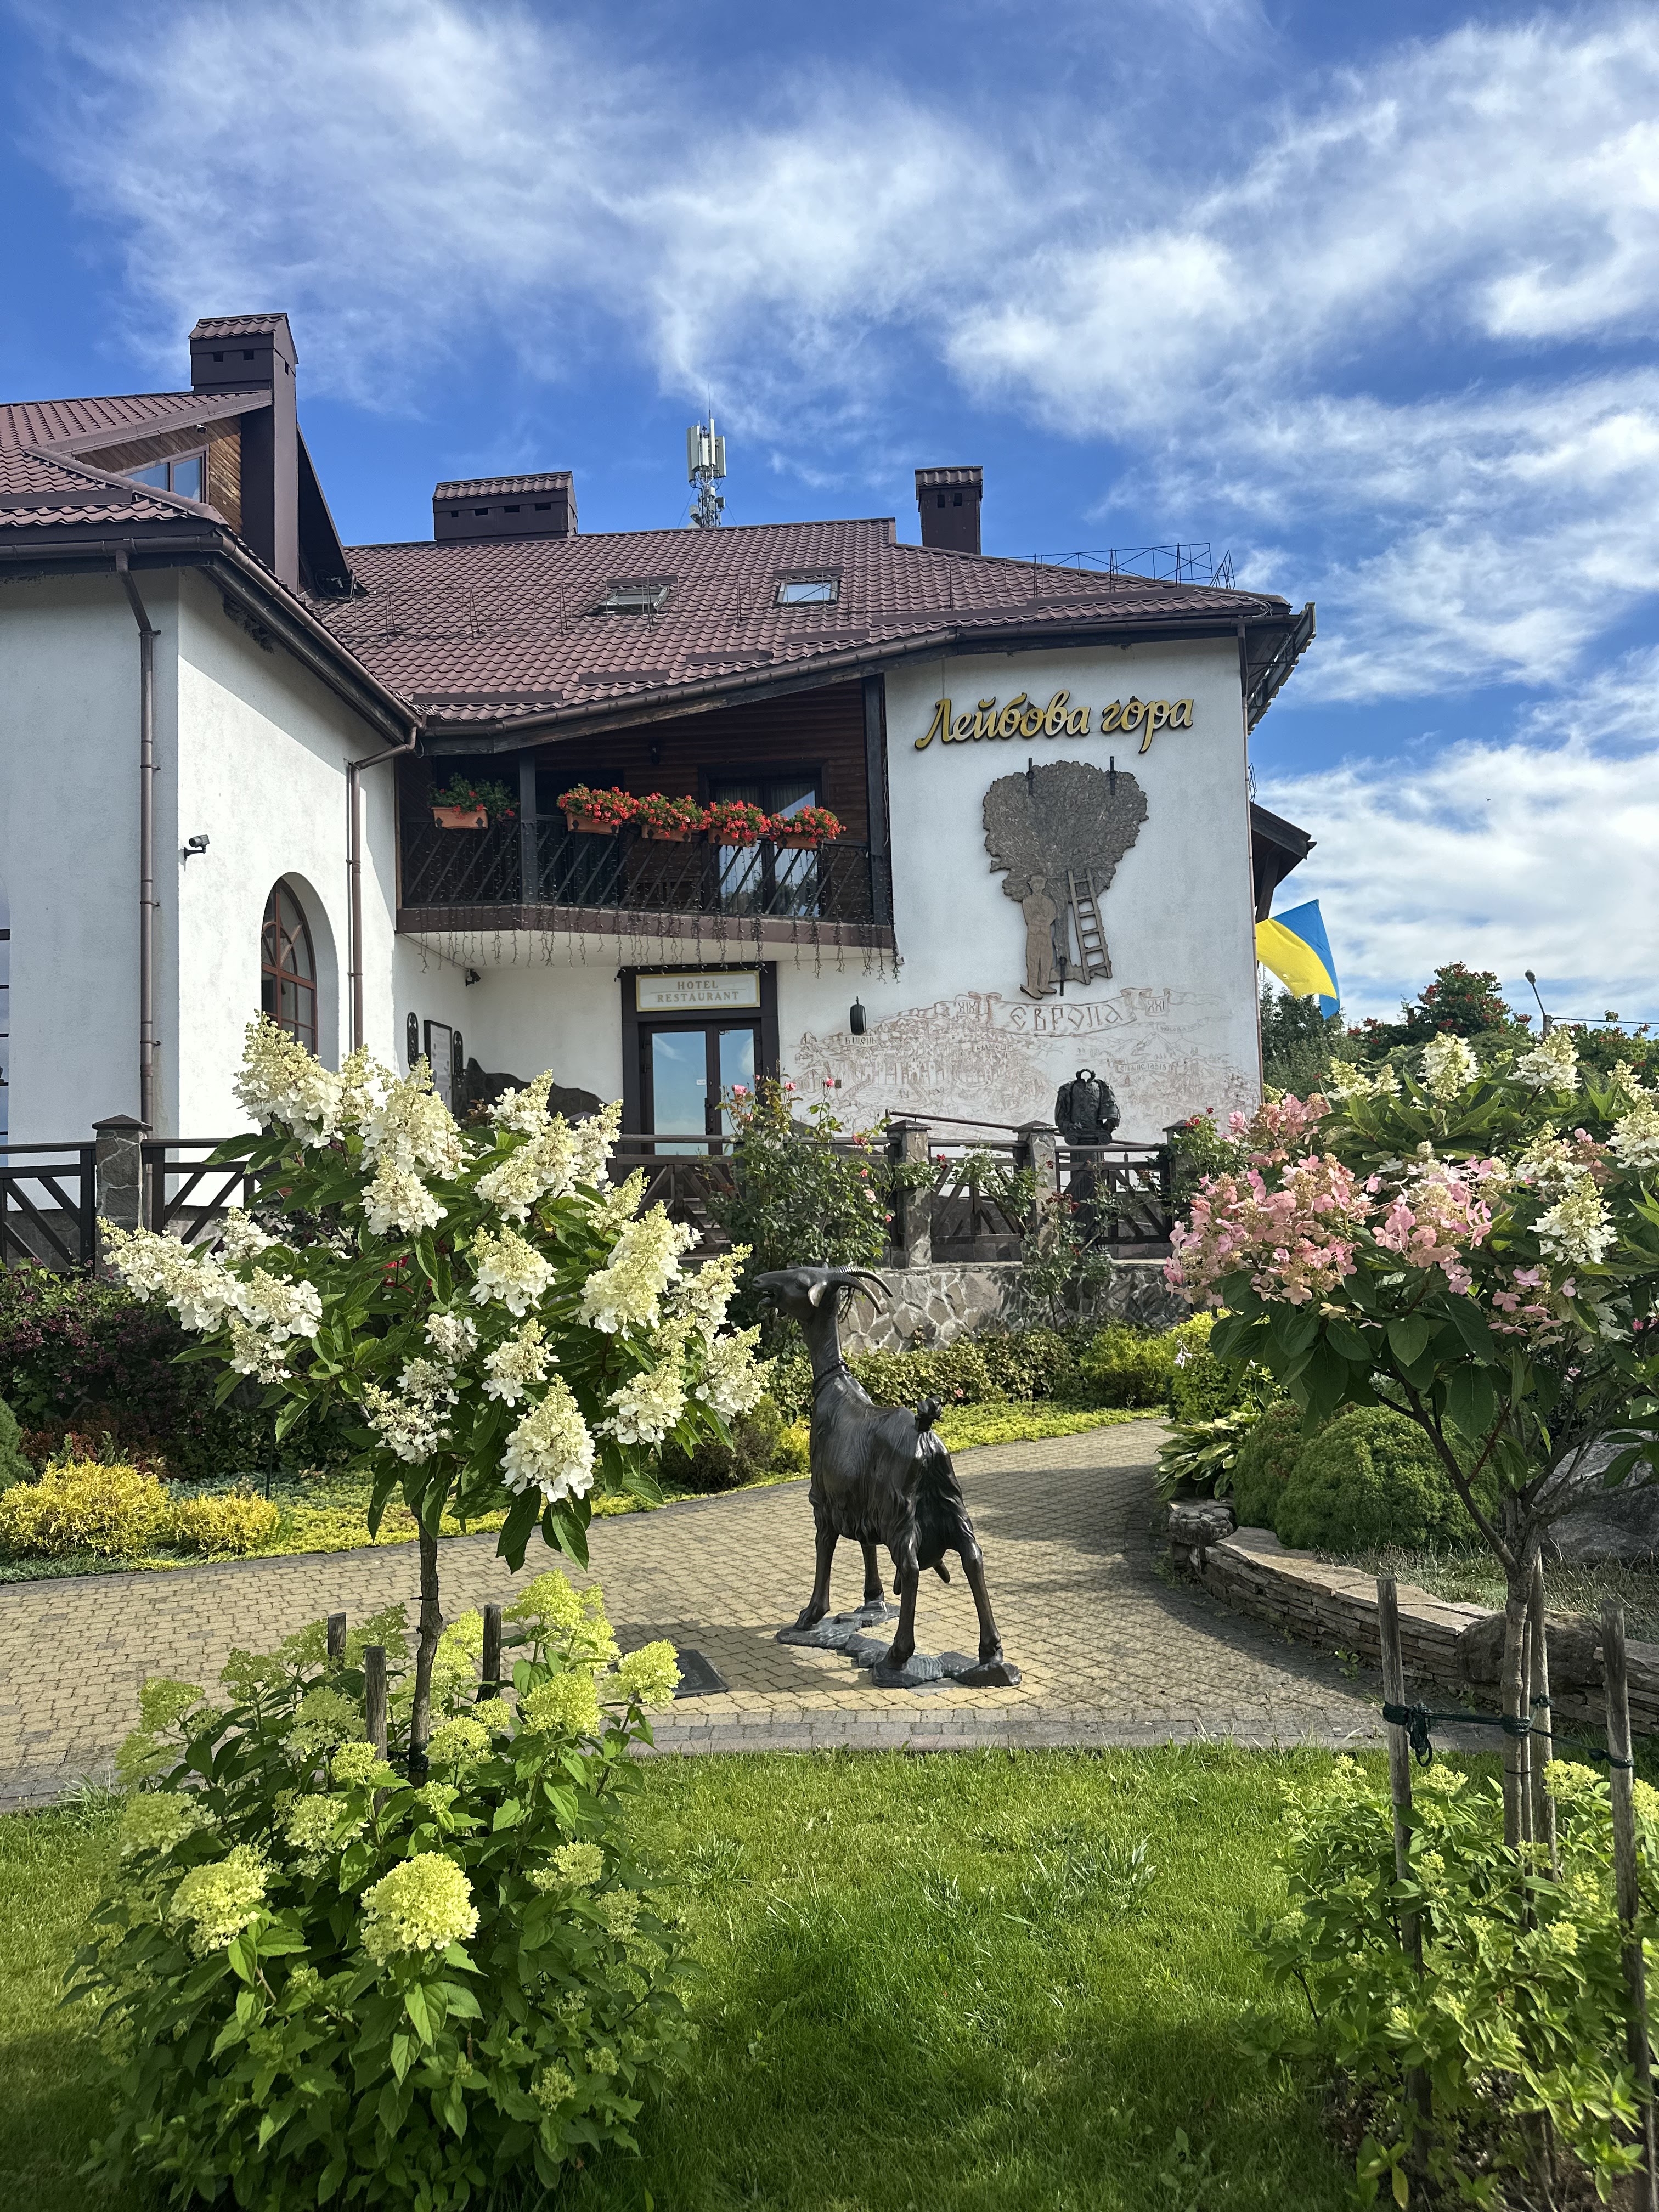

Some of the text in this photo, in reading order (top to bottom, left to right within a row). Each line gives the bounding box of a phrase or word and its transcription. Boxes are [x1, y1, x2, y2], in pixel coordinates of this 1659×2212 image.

[915, 689, 1194, 754] Лейбова гора
[677, 980, 719, 990] HOTEL
[657, 991, 739, 1003] RESTAURANT
